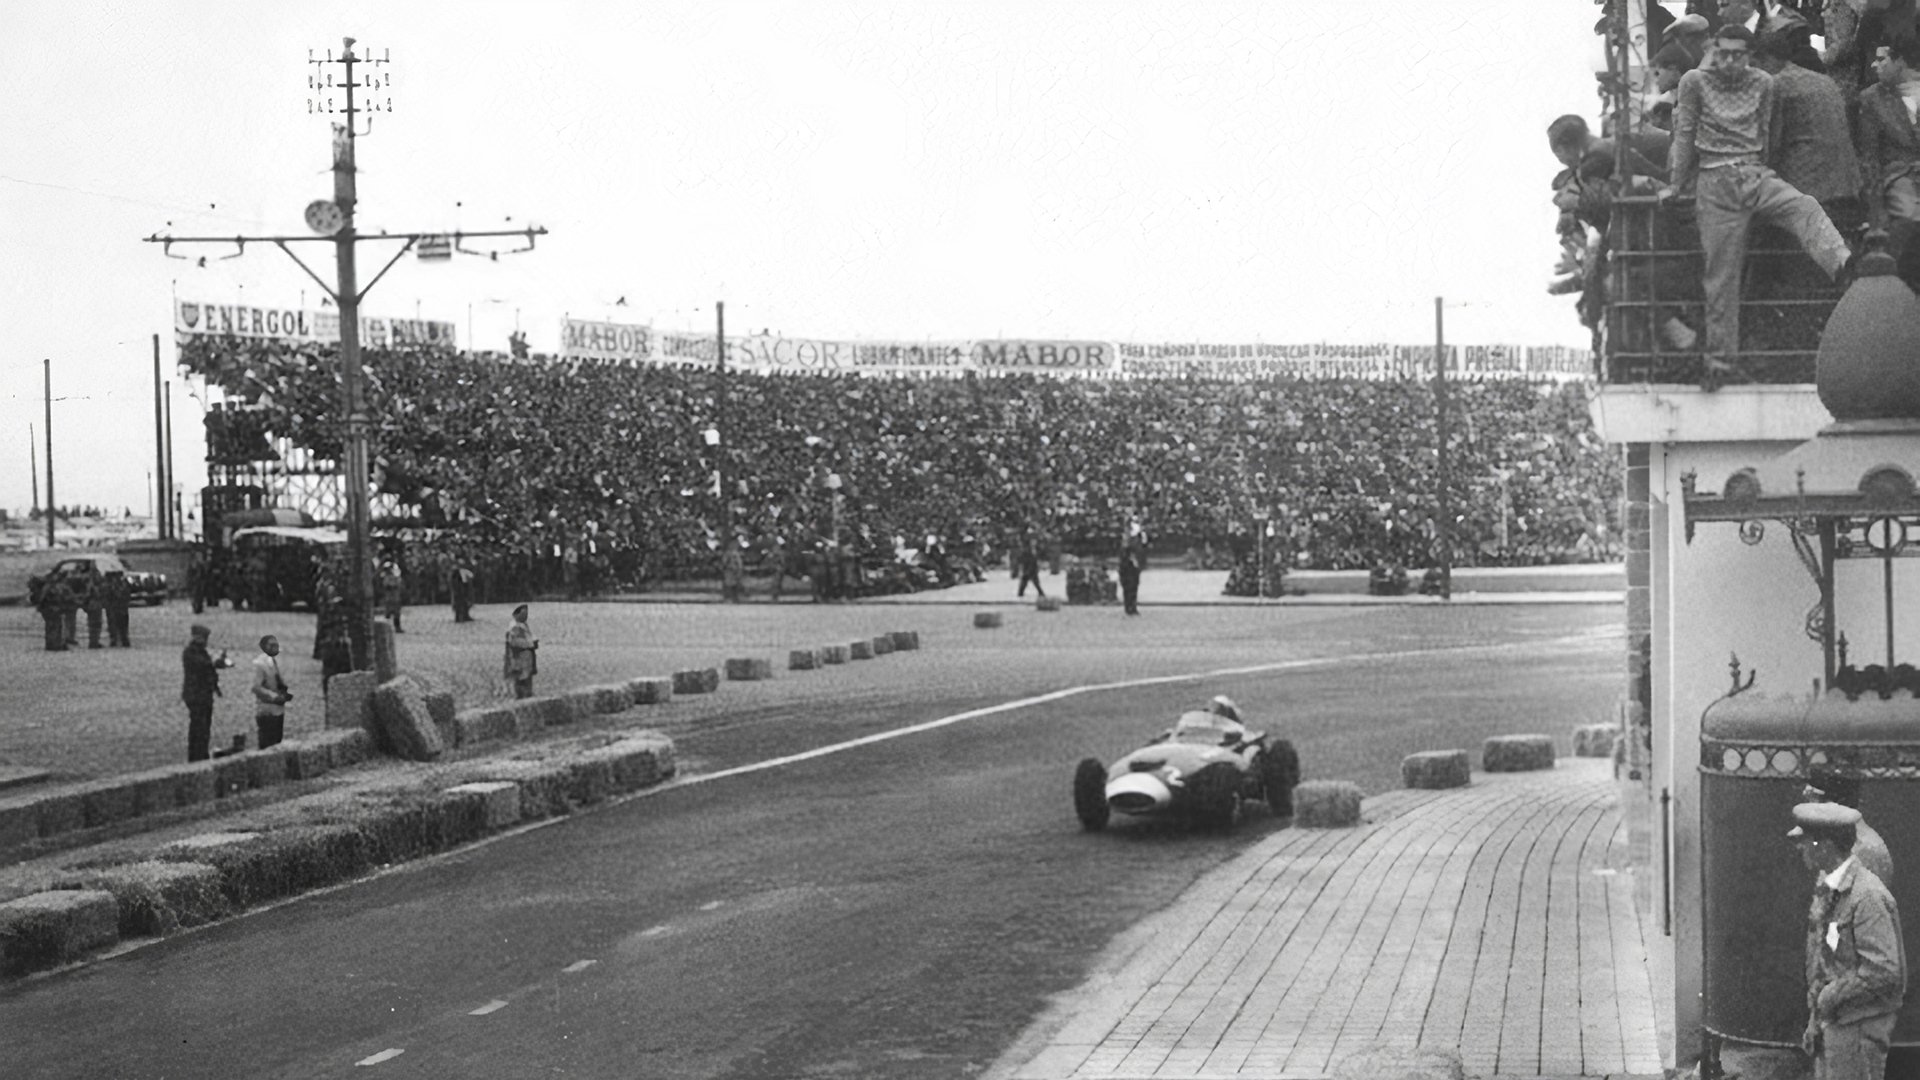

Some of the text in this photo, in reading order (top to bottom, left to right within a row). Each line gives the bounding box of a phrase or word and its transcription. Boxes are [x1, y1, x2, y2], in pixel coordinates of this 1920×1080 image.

[205, 304, 310, 336] ENERGOL
[566, 324, 648, 353] MABOR
[741, 340, 840, 369] SACOR
[981, 345, 1105, 366] MABOR
[1162, 765, 1185, 787] 2
